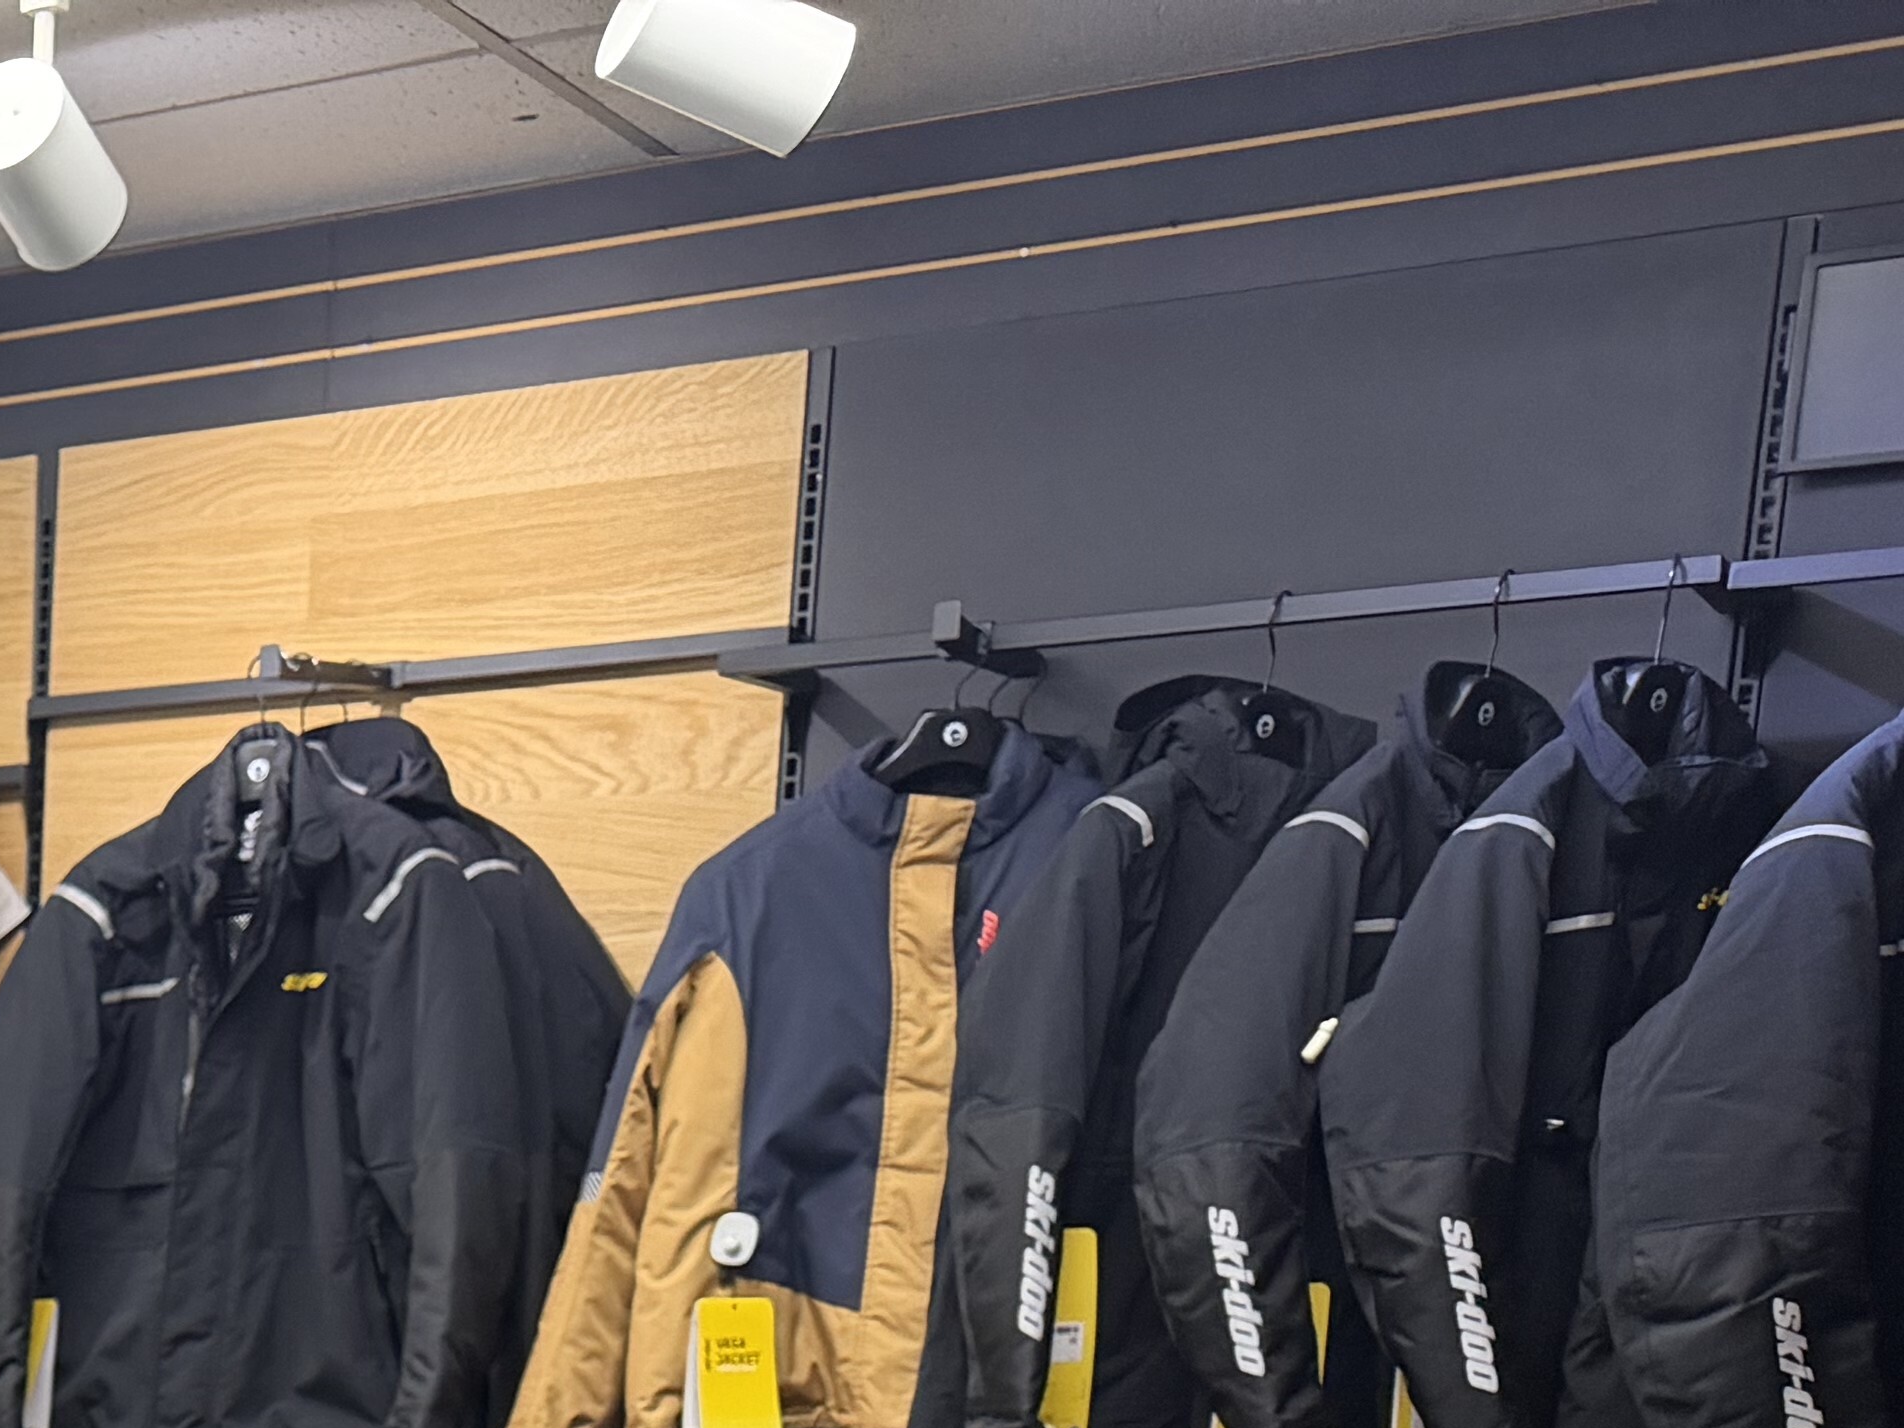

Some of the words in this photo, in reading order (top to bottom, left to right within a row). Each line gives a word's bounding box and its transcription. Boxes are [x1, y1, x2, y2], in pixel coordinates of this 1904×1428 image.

[1017, 1164, 1059, 1343] ski-doo
[1208, 1206, 1265, 1378] ski-doo
[1440, 1216, 1499, 1394] ski-doo
